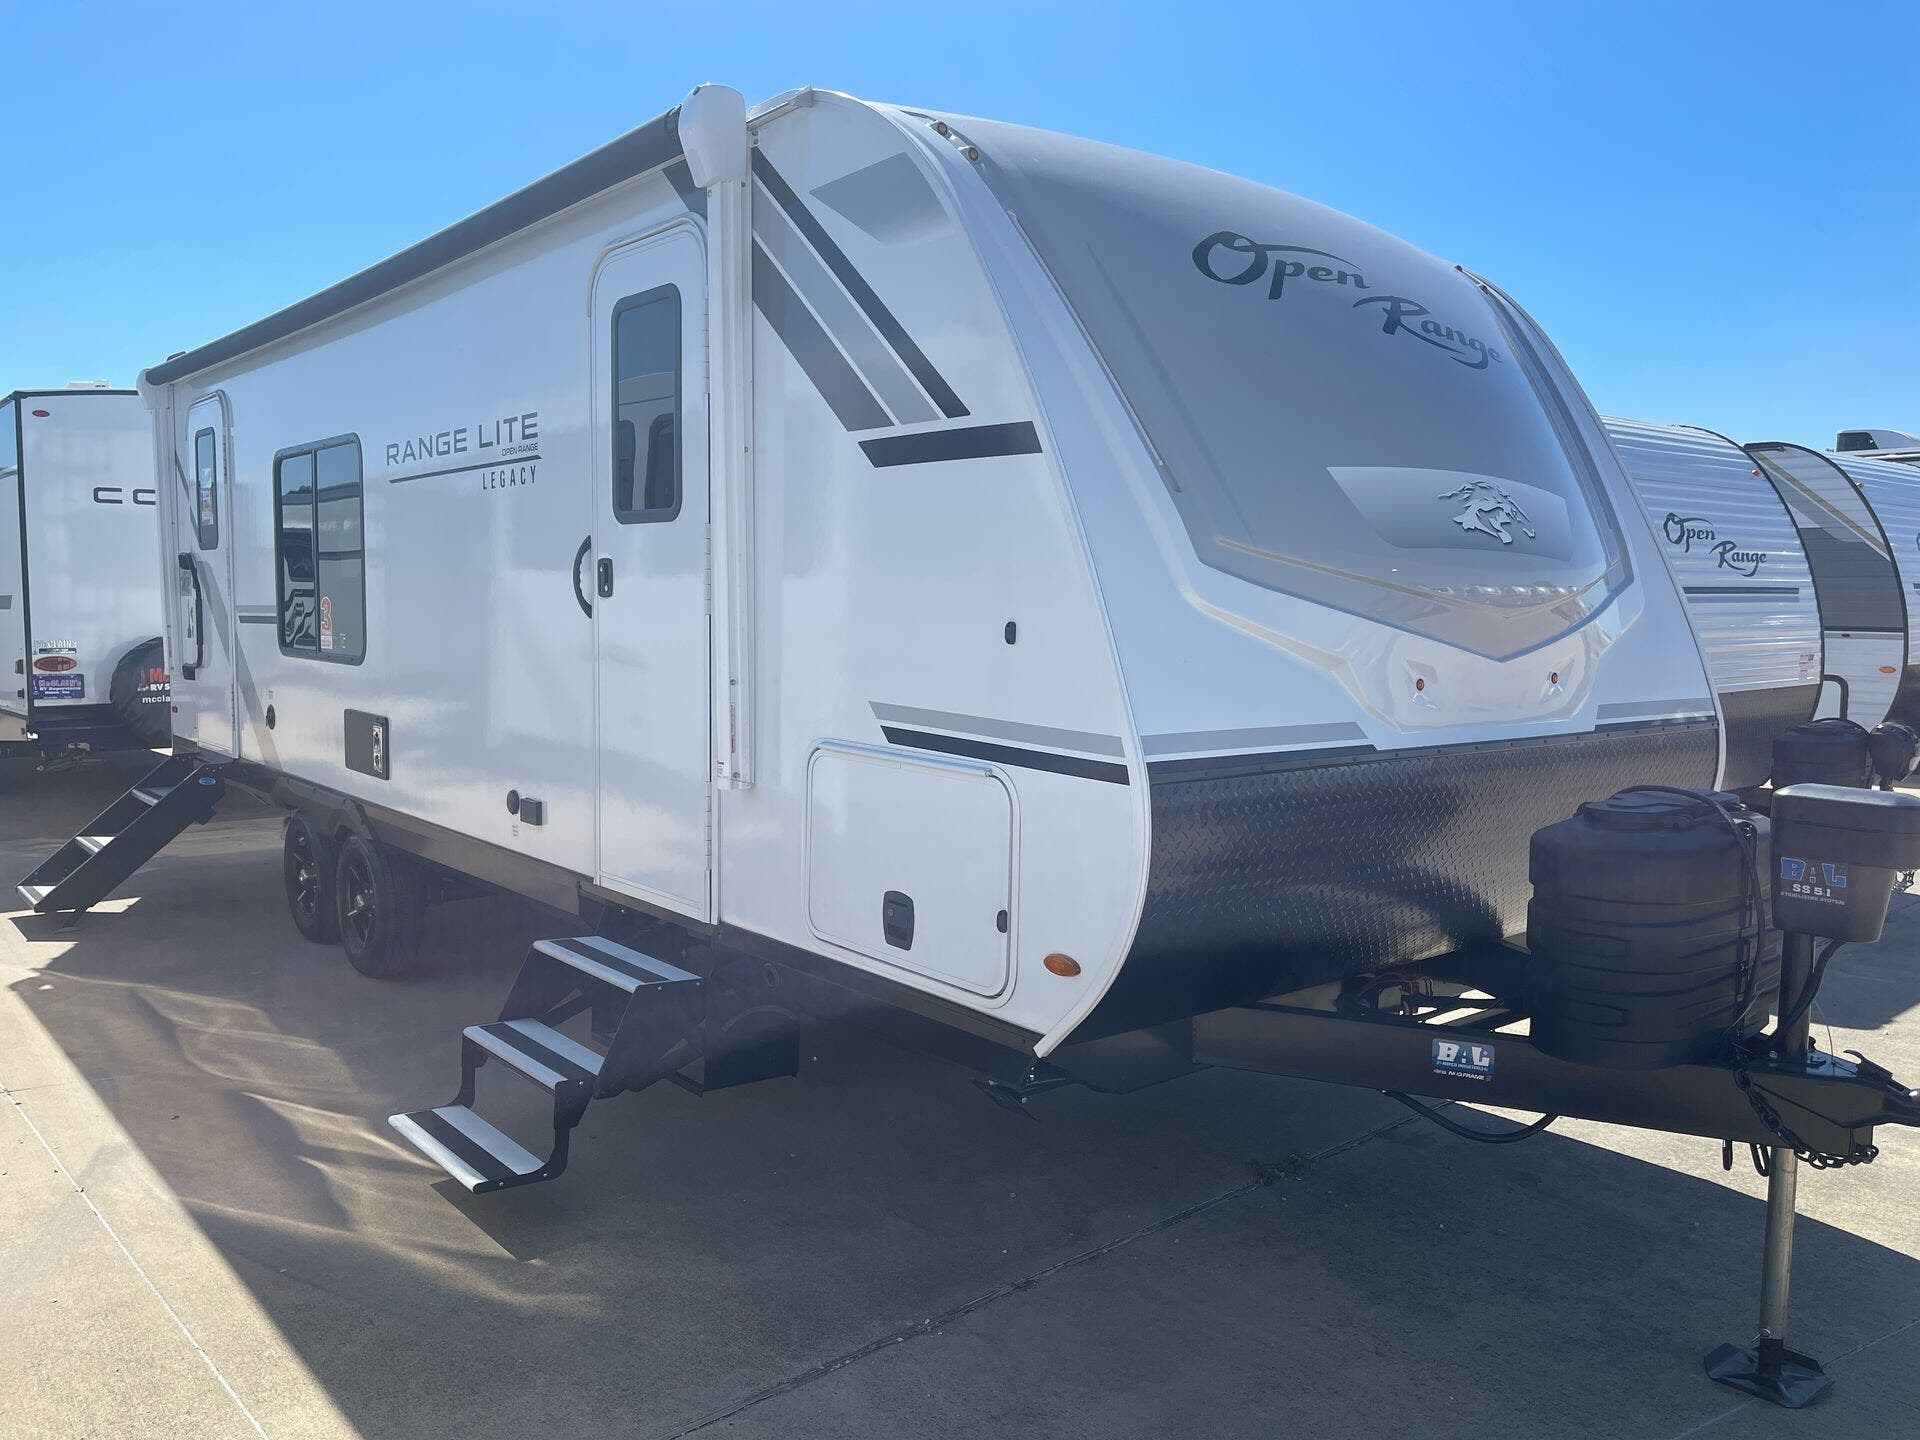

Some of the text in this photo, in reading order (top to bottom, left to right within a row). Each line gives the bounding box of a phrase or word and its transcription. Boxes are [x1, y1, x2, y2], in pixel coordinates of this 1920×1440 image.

[1192, 230, 1371, 301] Open
[1352, 295, 1504, 370] Range
[386, 411, 538, 466] RANGE LITE
[501, 442, 538, 457] OPEN RANGE
[482, 465, 537, 490] LEGACY
[1663, 512, 1718, 553] Open
[1709, 540, 1768, 577] Range
[1780, 856, 1847, 889] BAL
[1437, 1042, 1490, 1067] BAL
